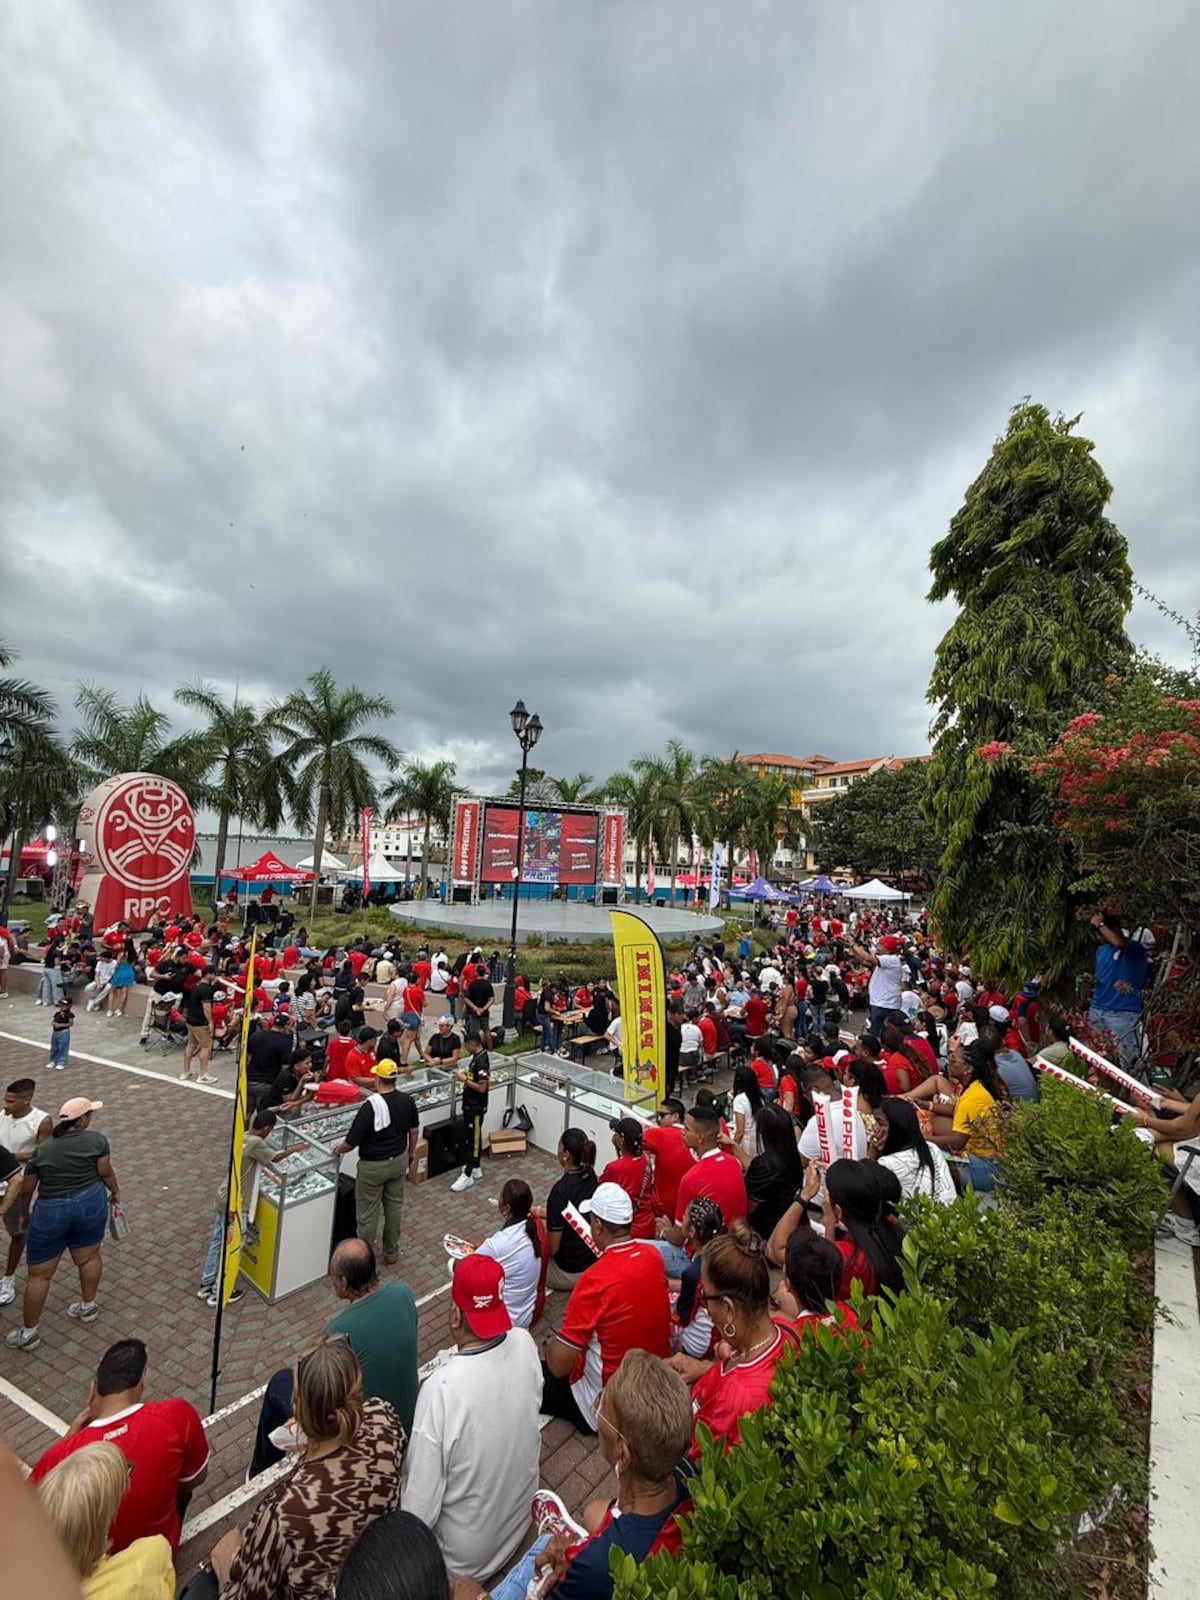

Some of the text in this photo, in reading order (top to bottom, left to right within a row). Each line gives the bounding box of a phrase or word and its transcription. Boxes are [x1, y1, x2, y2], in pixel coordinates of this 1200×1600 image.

[461, 809, 472, 859] PREMIER
[609, 819, 618, 864] PREMIER
[124, 896, 171, 918] RPC
[1088, 1057, 1153, 1104] PREMIER
[814, 1102, 830, 1164] EMIER
